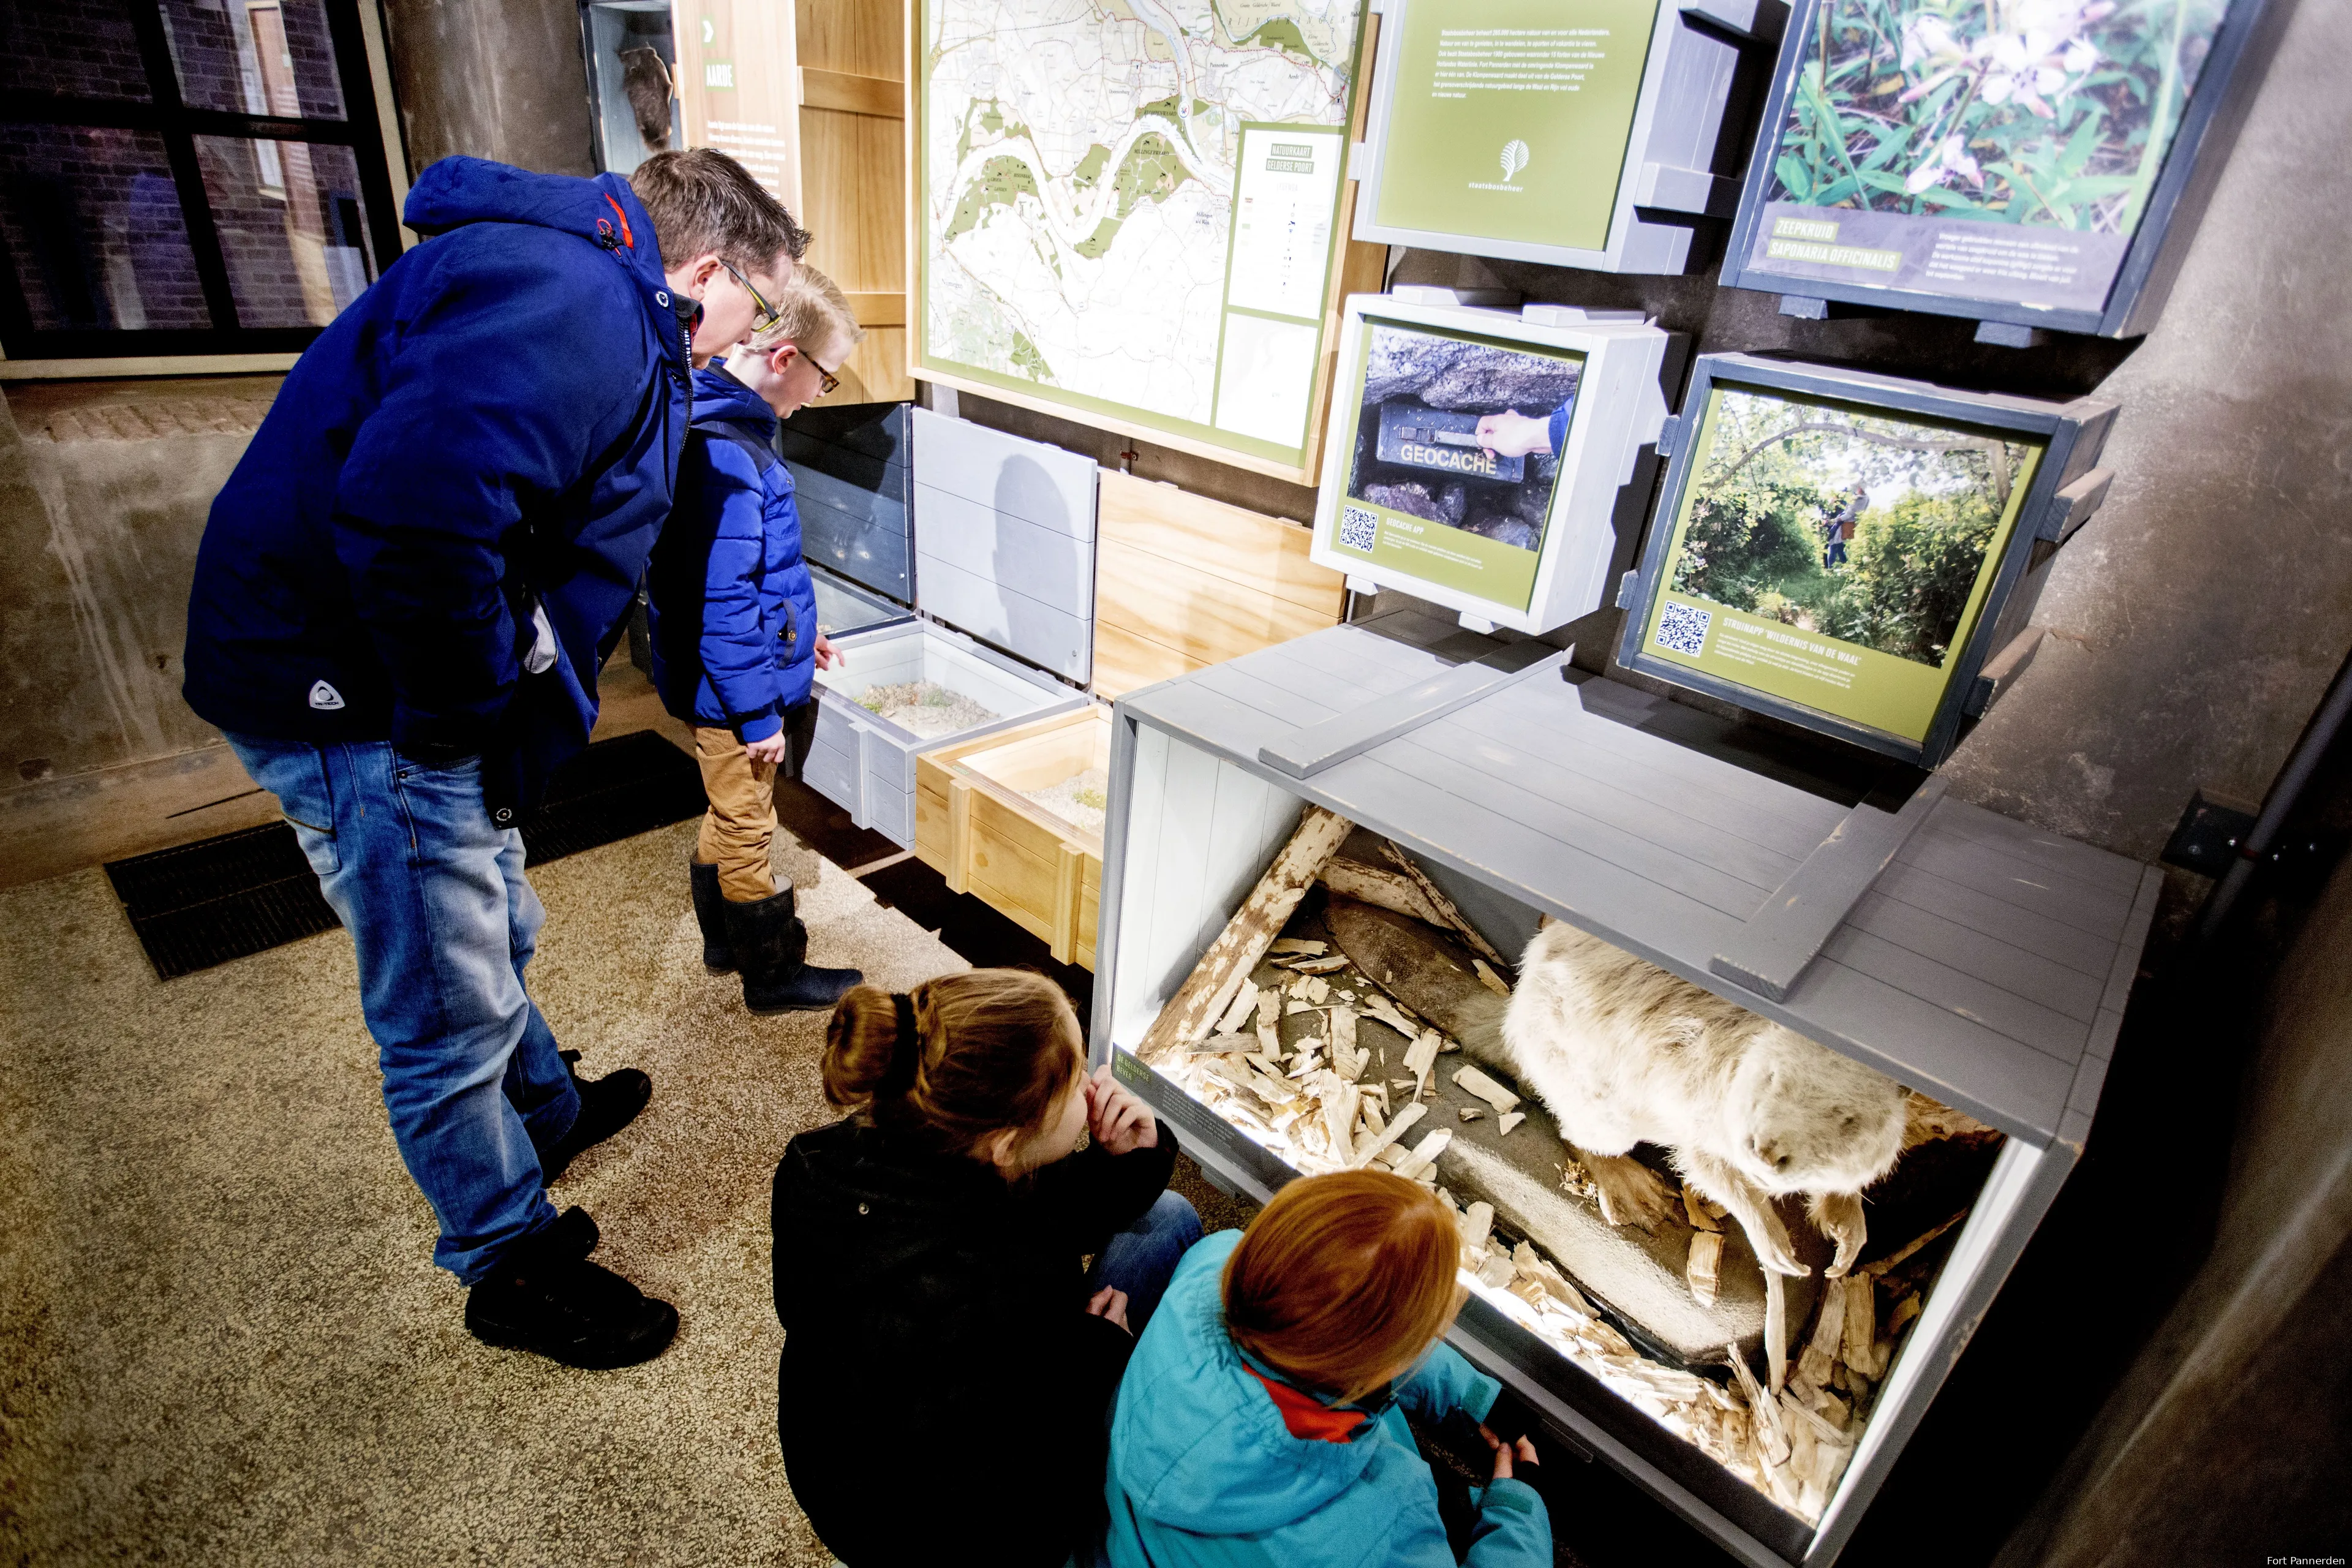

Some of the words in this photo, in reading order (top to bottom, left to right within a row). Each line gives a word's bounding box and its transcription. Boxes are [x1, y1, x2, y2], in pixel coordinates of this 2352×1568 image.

[706, 64, 734, 88] AARDE
[1271, 145, 1311, 157] NATUURKAART
[1267, 161, 1293, 172] GELDERSE
[1294, 163, 1313, 173] POORT
[1468, 183, 1524, 193] staatsbosbeheer
[1776, 220, 1834, 239] ZEEPKRUID
[1770, 242, 1828, 261] SAPONARIA
[1829, 249, 1896, 269] OFFICINALIS
[1401, 444, 1498, 475] GEOCACHE
[1386, 517, 1413, 532] GEOCACHE
[1412, 525, 1424, 535] APP
[1722, 617, 1764, 636] STRUINAPP
[1809, 642, 1826, 655] VAN
[1825, 647, 1838, 659] DE
[1117, 1054, 1124, 1064] DE
[1125, 1058, 1150, 1082] GELDERSE
[1117, 1065, 1133, 1081] BEVER
